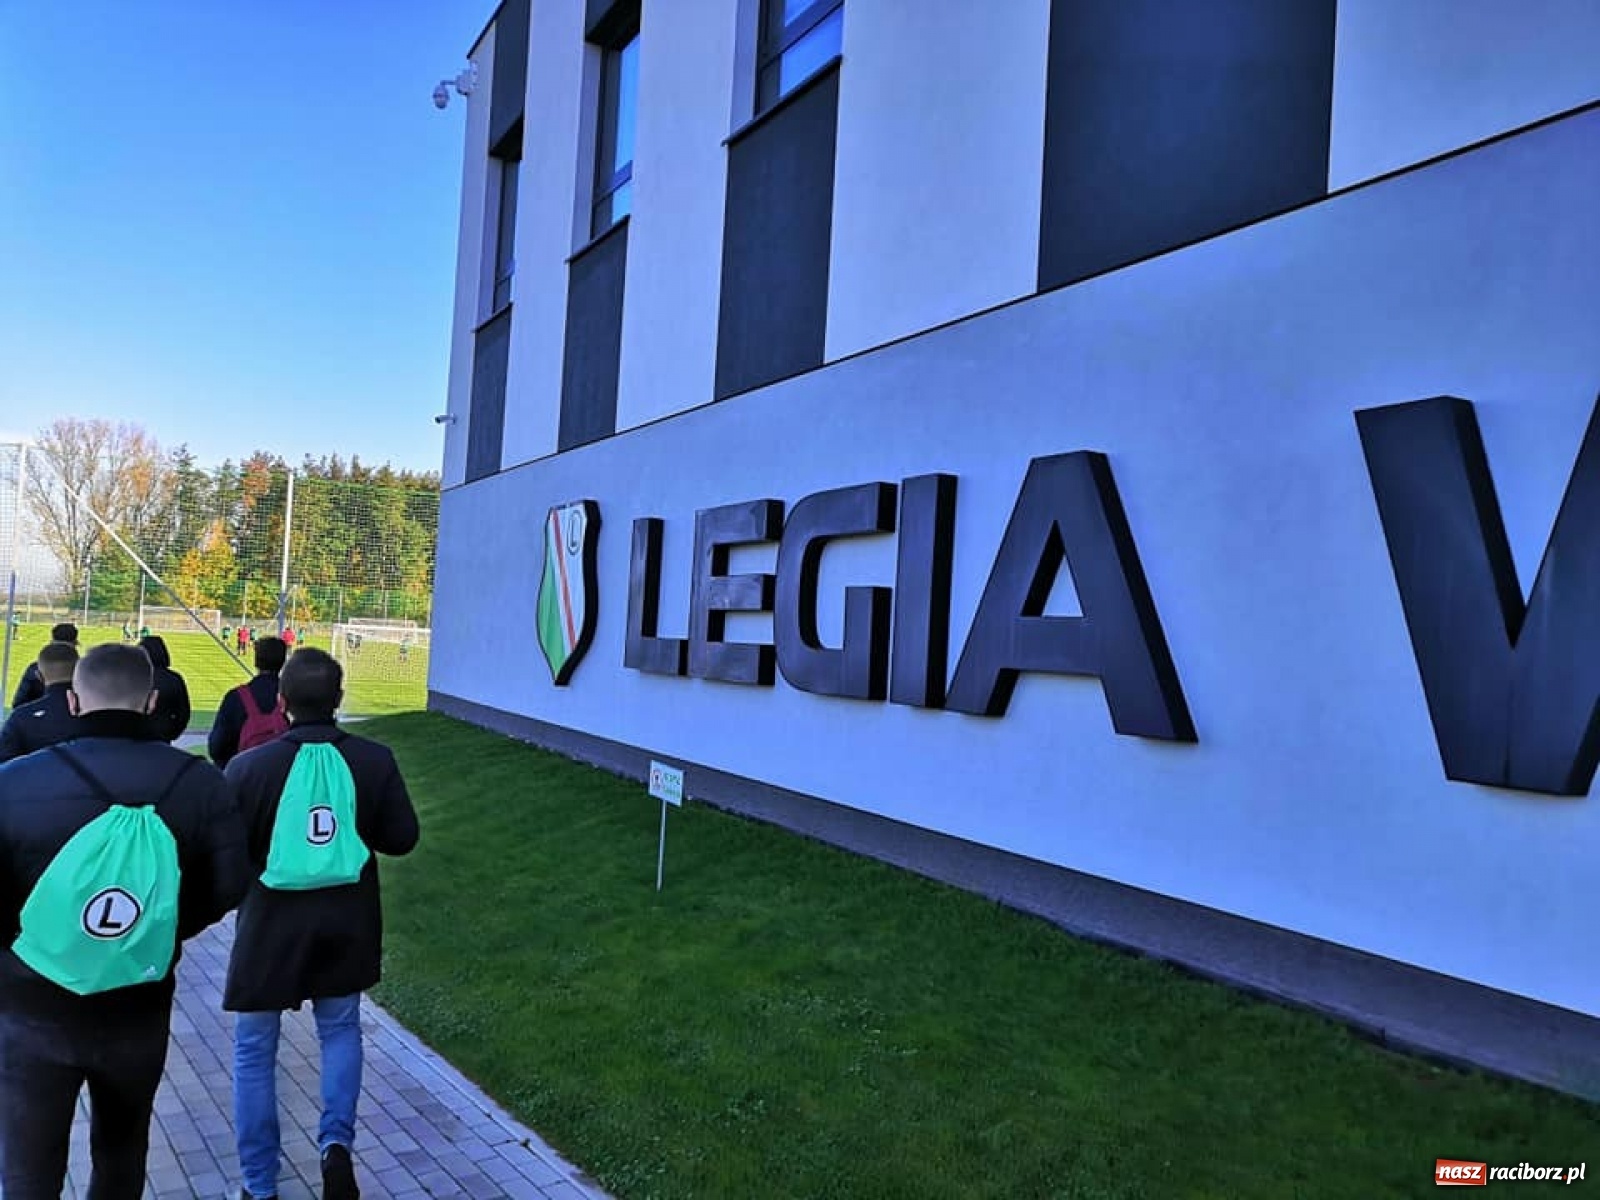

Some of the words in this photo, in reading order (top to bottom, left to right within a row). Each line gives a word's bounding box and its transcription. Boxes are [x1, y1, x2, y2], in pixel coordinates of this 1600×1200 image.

[624, 450, 1199, 744] LEGIA
[313, 812, 330, 837] L
[98, 896, 122, 929] L
